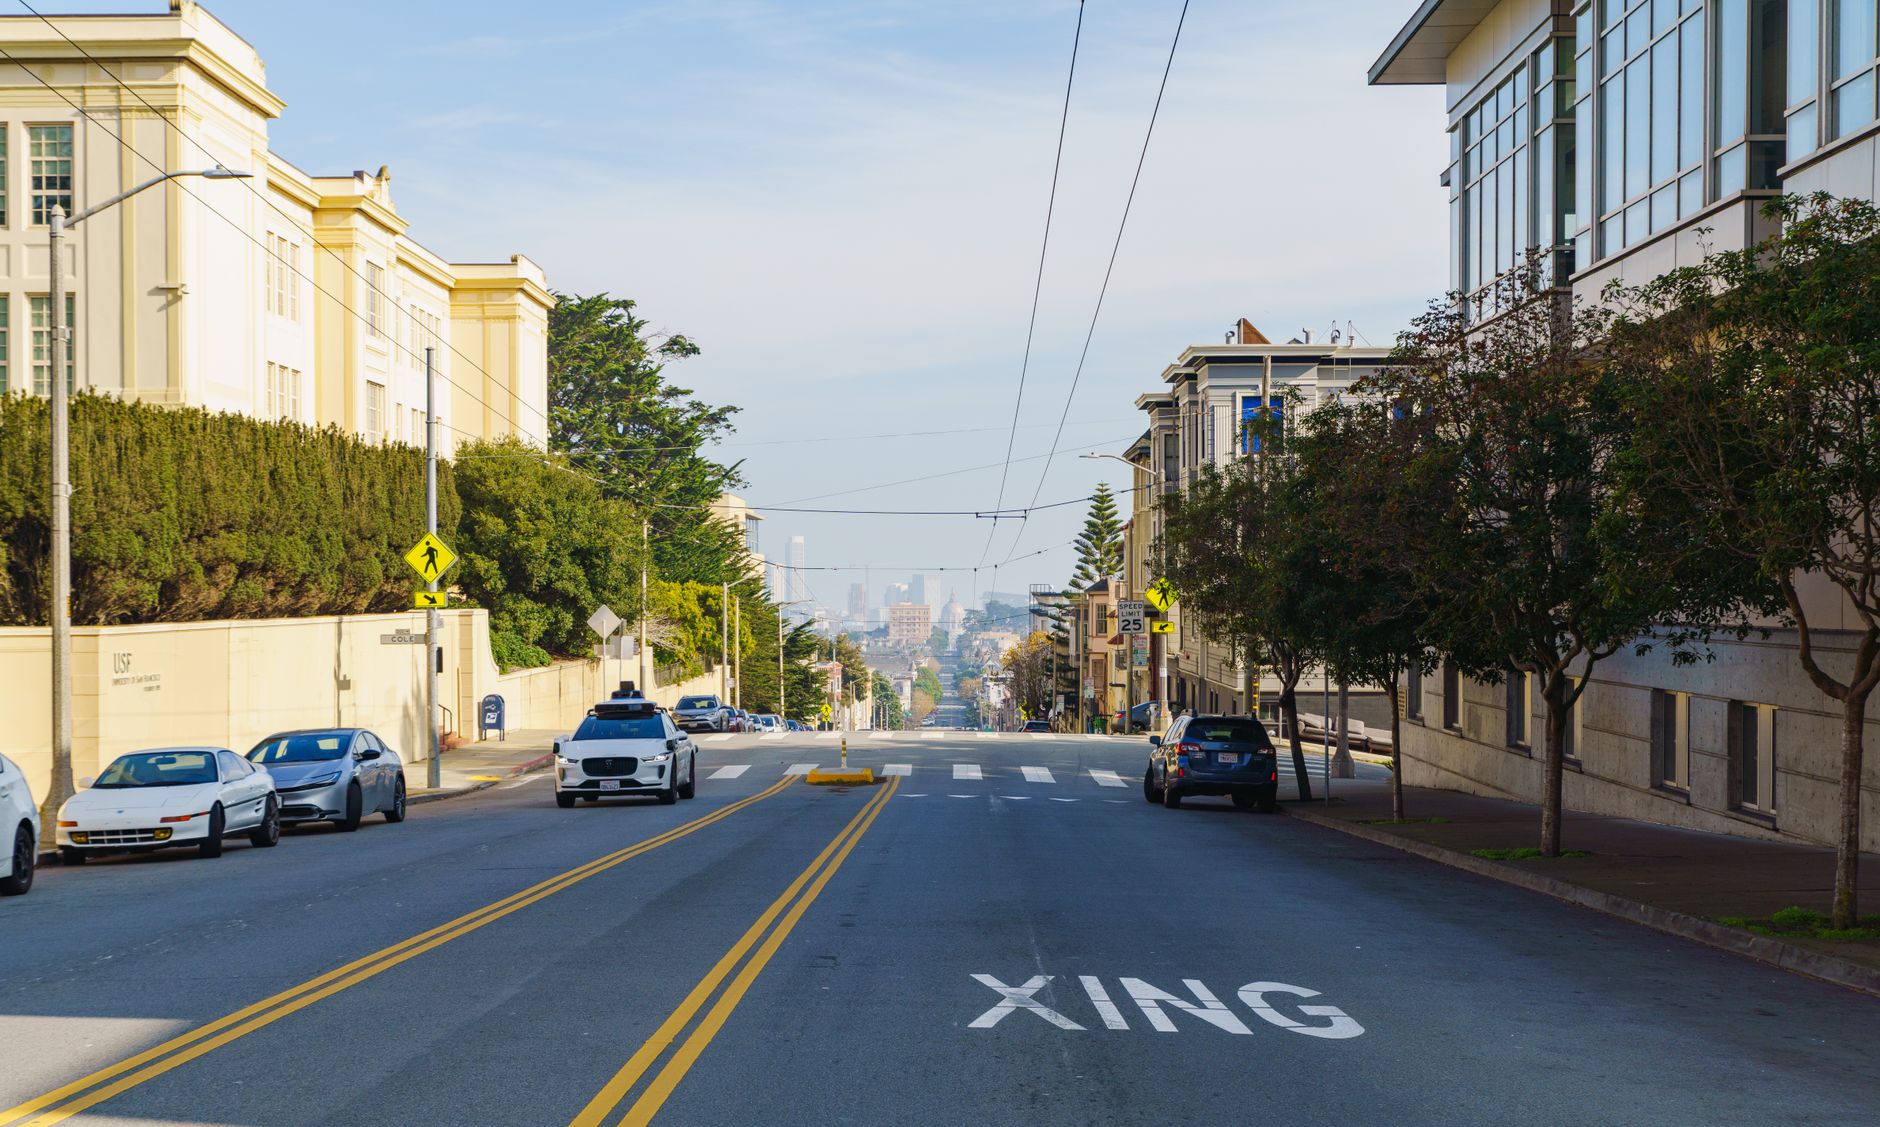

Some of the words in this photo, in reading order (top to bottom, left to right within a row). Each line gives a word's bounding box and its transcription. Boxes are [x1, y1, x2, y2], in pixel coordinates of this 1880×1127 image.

[1121, 619, 1142, 632] 25
[113, 653, 132, 673] USF
[967, 973, 1366, 1039] XING
